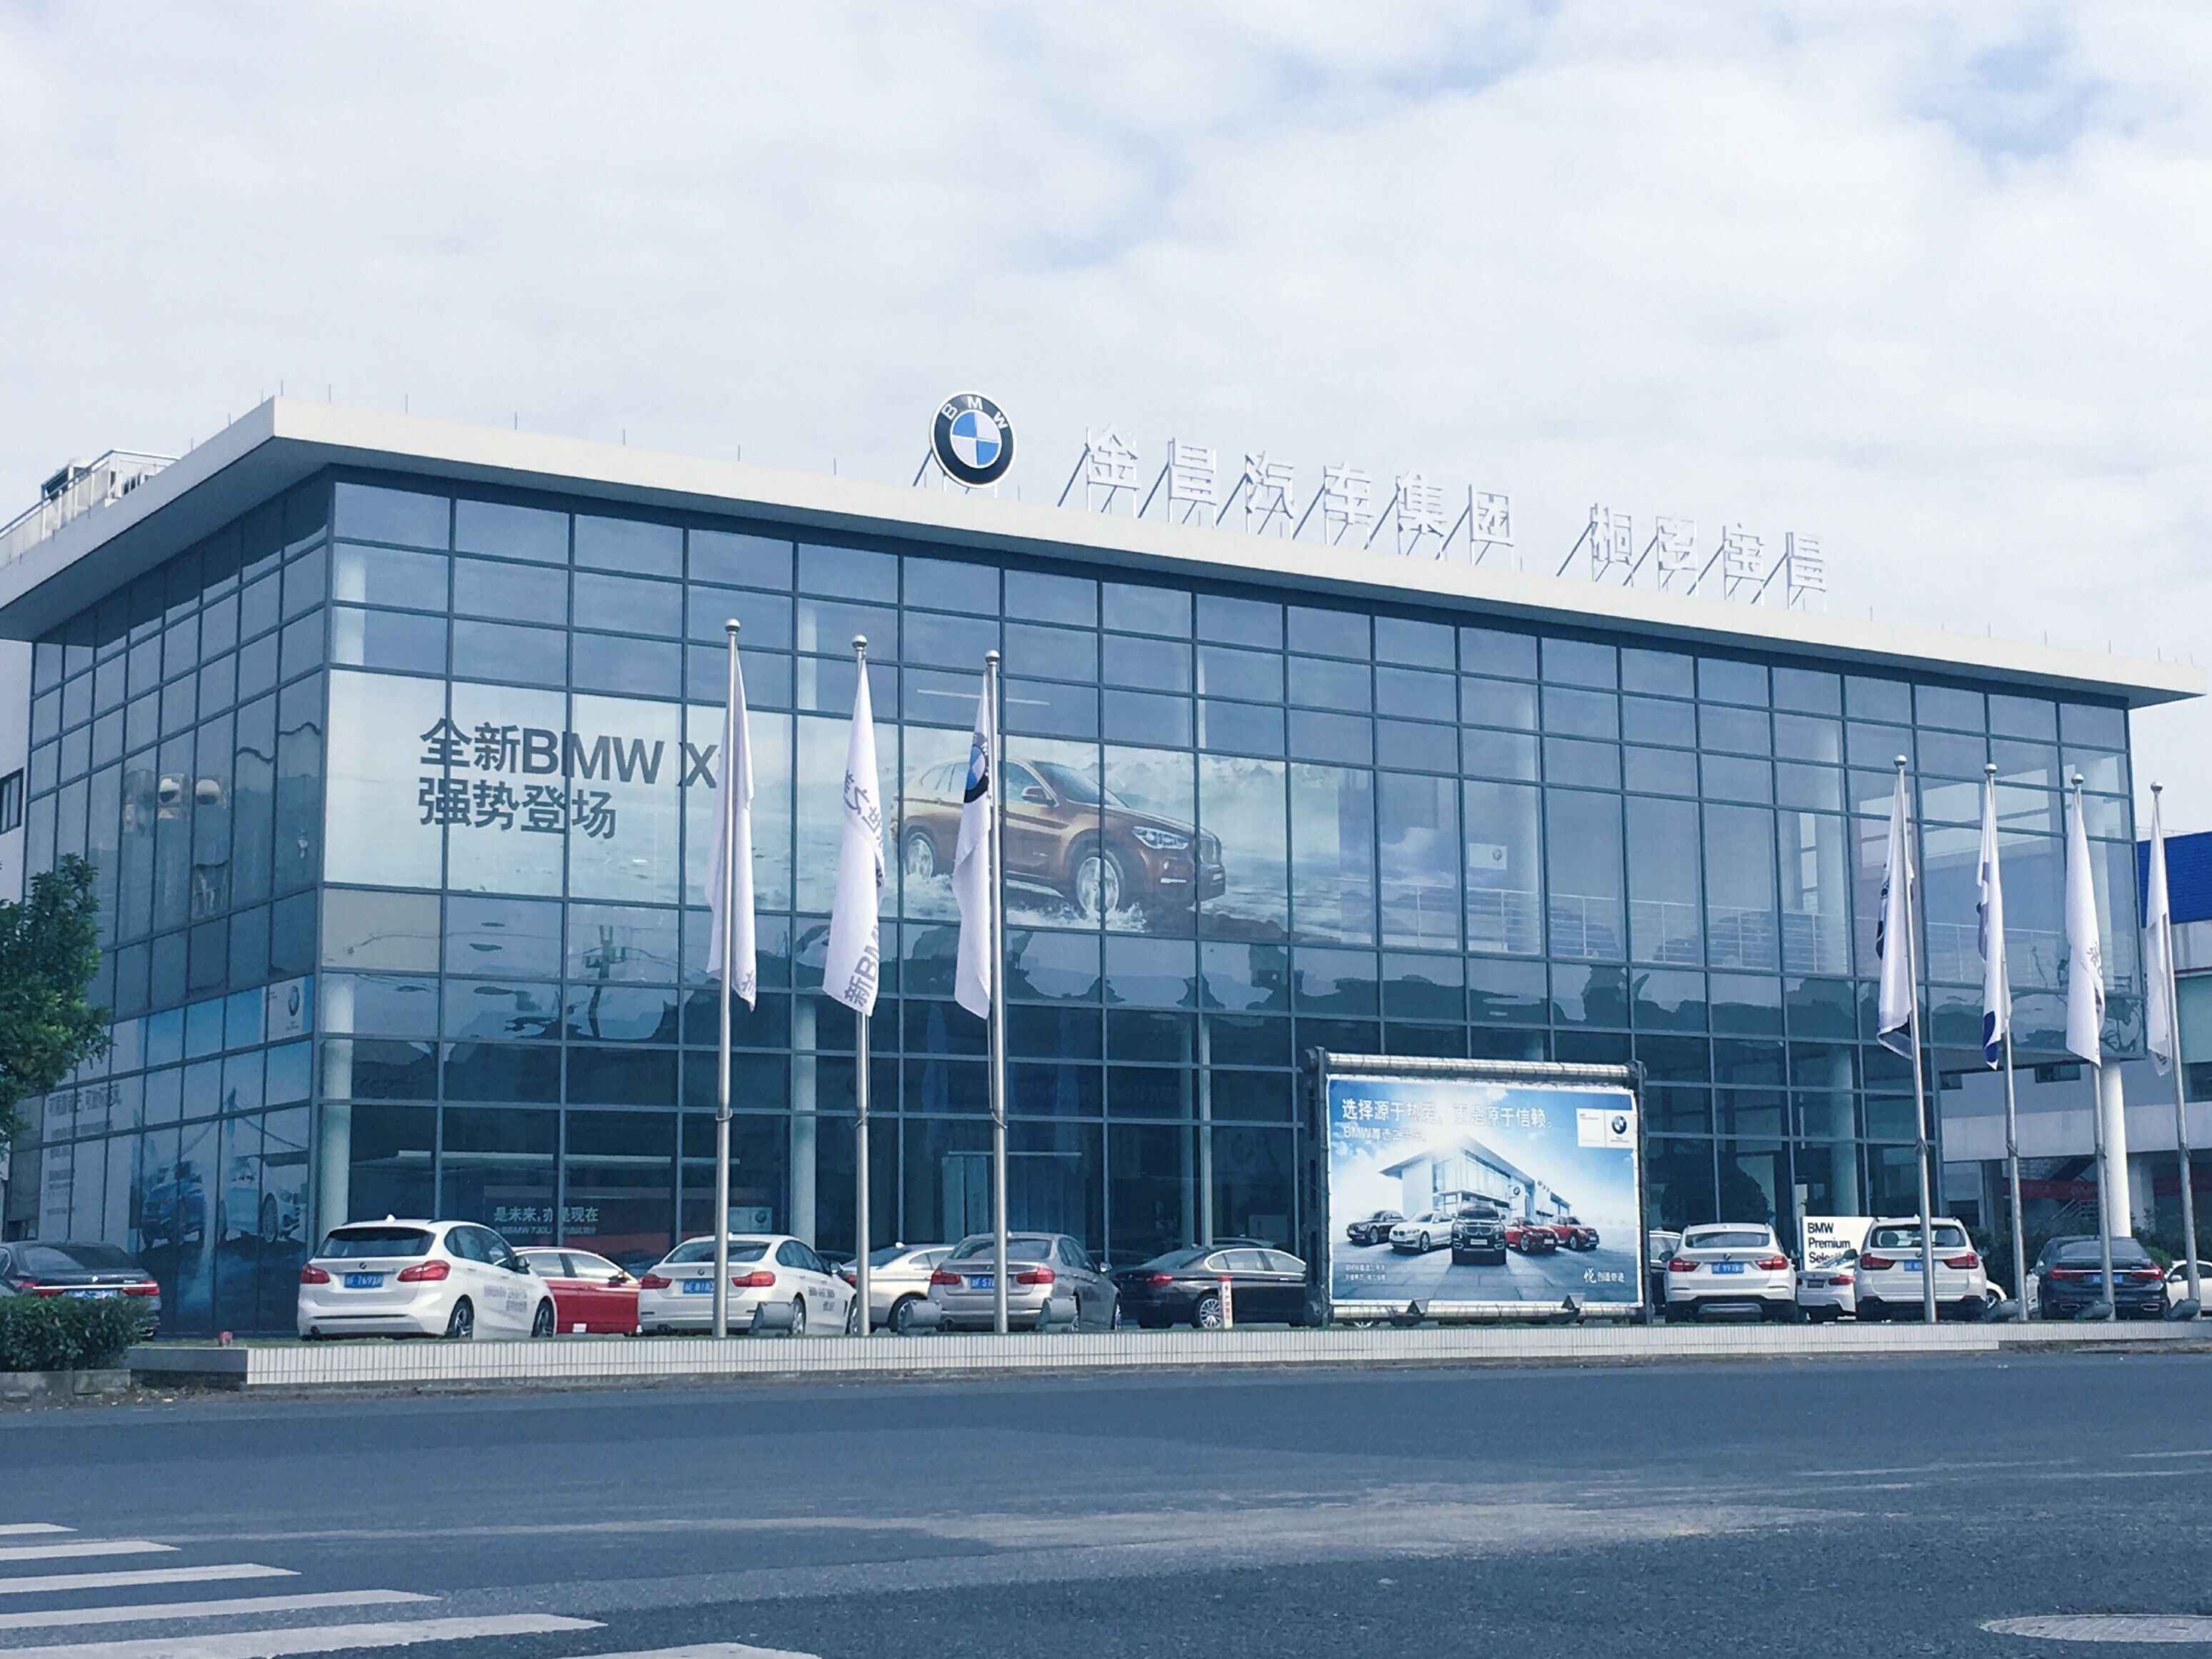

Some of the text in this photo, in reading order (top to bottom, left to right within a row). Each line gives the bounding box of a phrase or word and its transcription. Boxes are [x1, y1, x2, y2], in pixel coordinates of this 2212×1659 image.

[941, 396, 1008, 429] BMW
[419, 717, 665, 785] 全新BMW
[418, 776, 616, 840] 强势登场
[1808, 1222, 1833, 1233] BMW
[1808, 1237, 1851, 1248] Premium
